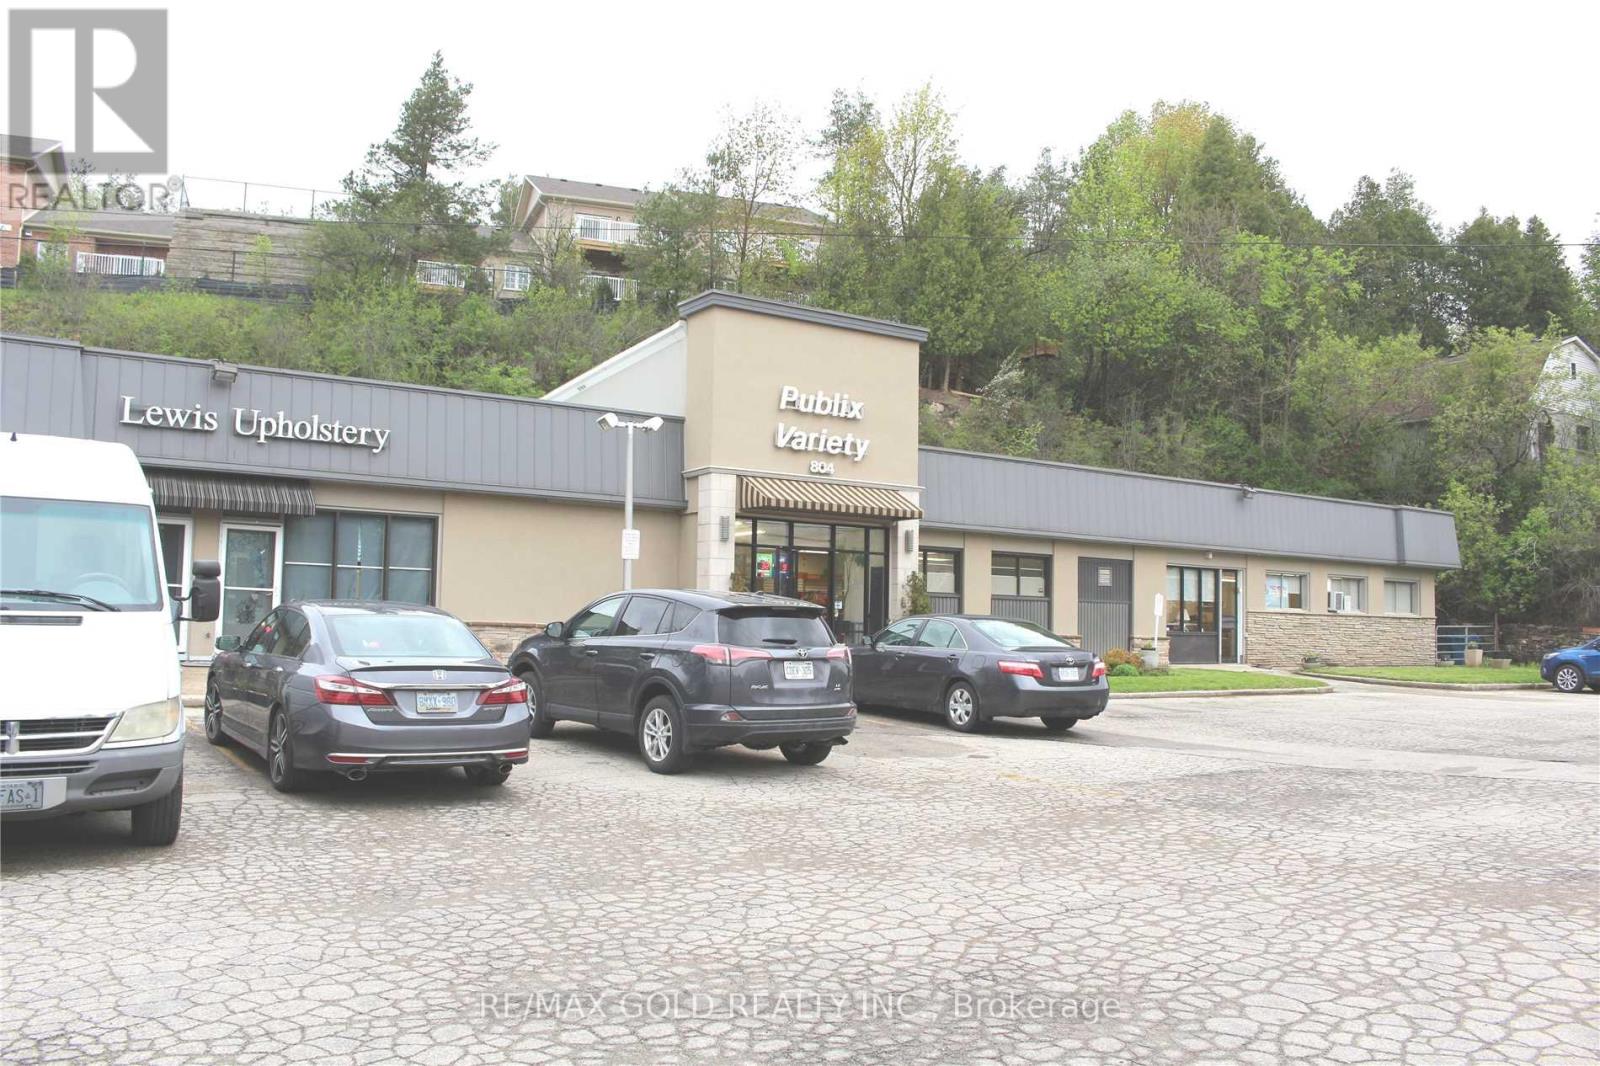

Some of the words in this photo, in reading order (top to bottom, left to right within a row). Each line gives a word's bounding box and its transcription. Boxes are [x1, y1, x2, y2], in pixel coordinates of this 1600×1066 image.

[779, 385, 865, 419] Publix
[119, 395, 219, 432] Lewis
[233, 407, 391, 453] Upholstery
[775, 422, 870, 462] Variety
[809, 460, 835, 475] 804
